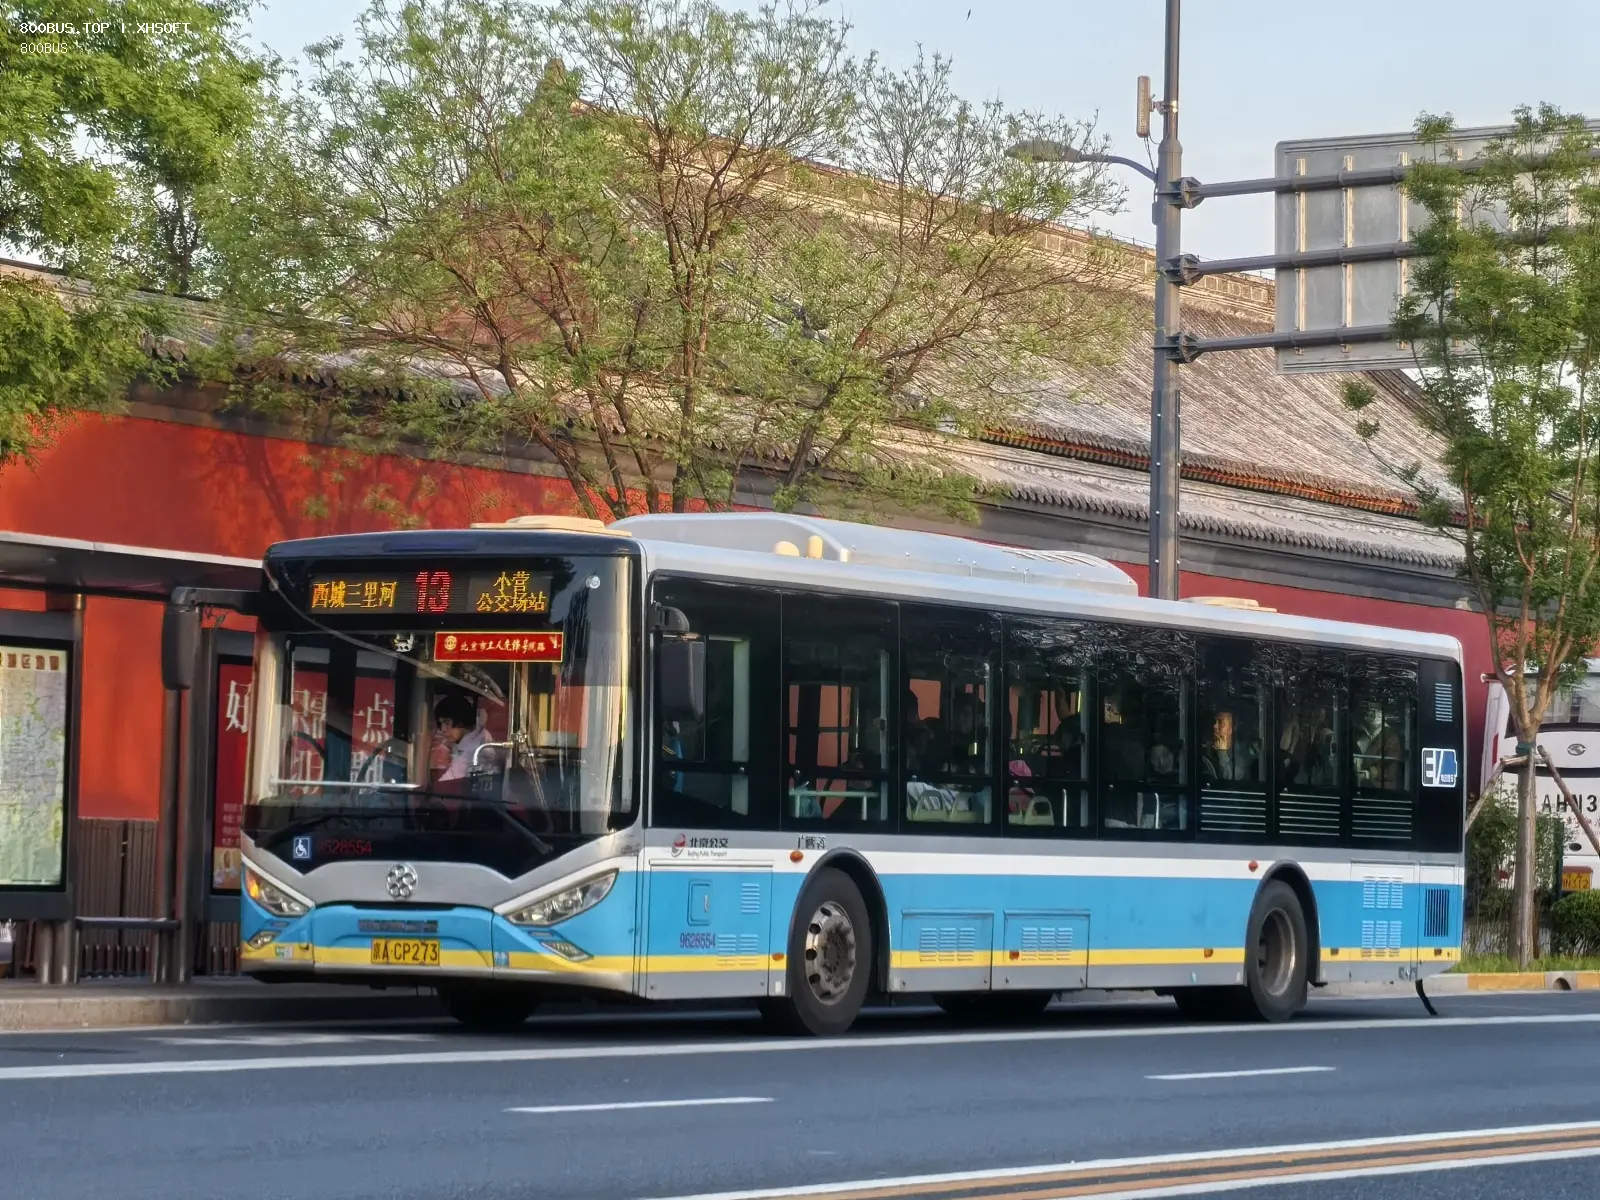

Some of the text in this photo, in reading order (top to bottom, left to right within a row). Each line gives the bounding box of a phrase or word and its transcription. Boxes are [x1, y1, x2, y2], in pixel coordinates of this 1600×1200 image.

[311, 581, 397, 608] 西城三里河
[415, 571, 451, 613] 13
[493, 571, 531, 595] 小营
[476, 590, 547, 613] 公交场站
[317, 838, 372, 855] 628554
[689, 836, 729, 848] 北京公交
[679, 932, 716, 949] 9628554
